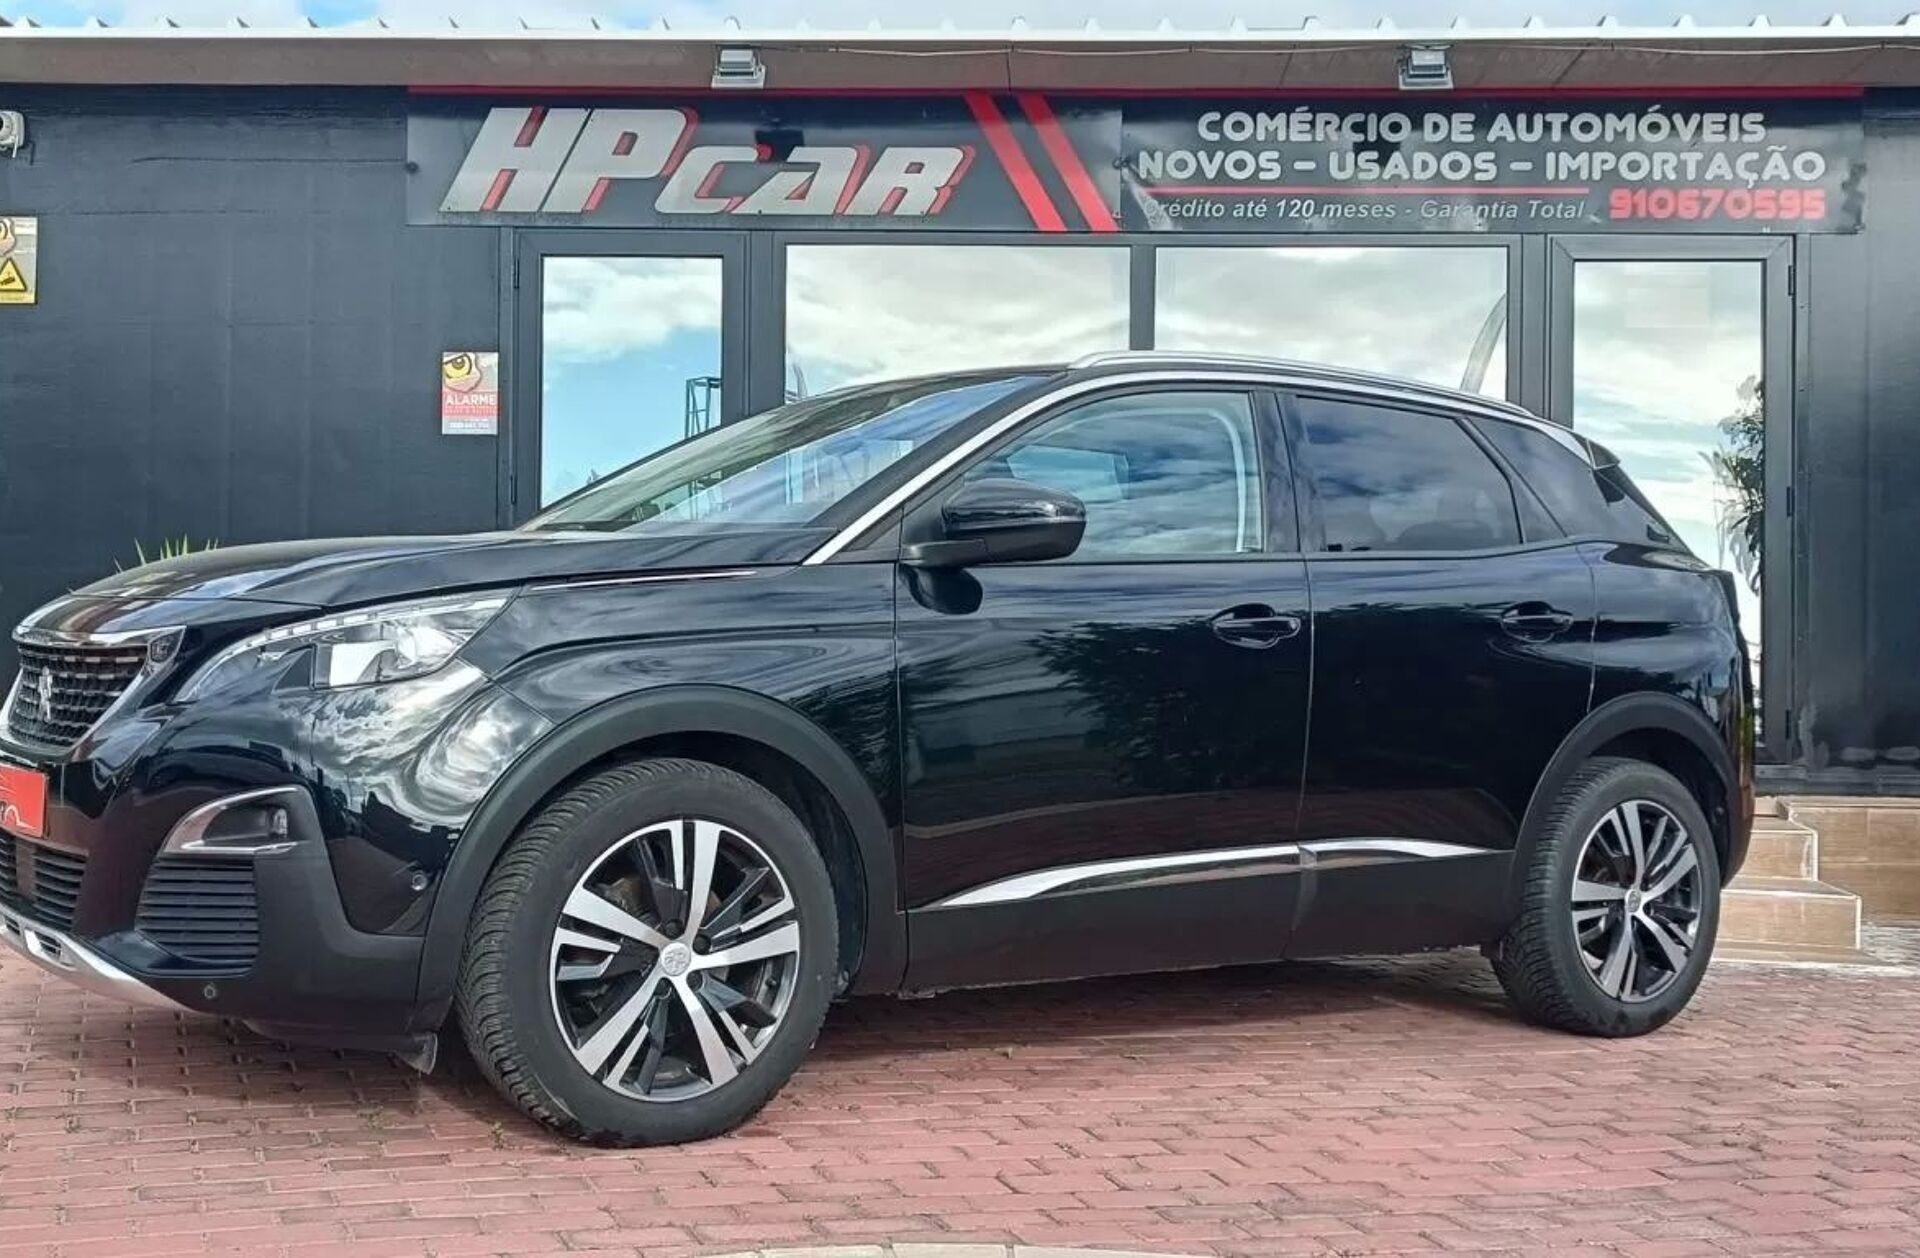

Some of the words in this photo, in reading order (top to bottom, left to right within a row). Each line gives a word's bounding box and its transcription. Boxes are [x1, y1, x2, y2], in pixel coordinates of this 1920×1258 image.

[1197, 106, 1412, 142] COMÉRCIO
[1423, 112, 1476, 142] DE
[1486, 105, 1767, 143] AUTOMÓVEIS
[1138, 150, 1282, 181] NOVOS
[1328, 151, 1498, 182] USADOS
[1545, 145, 1826, 188] IMPORTAÇÃO
[1232, 198, 1267, 218] até
[1276, 199, 1315, 218] 120
[1320, 203, 1397, 218] meses
[1420, 199, 1519, 219] Garantia
[1529, 199, 1585, 219] Total
[1609, 187, 1826, 220] 910670595
[446, 393, 497, 406] ALARME
